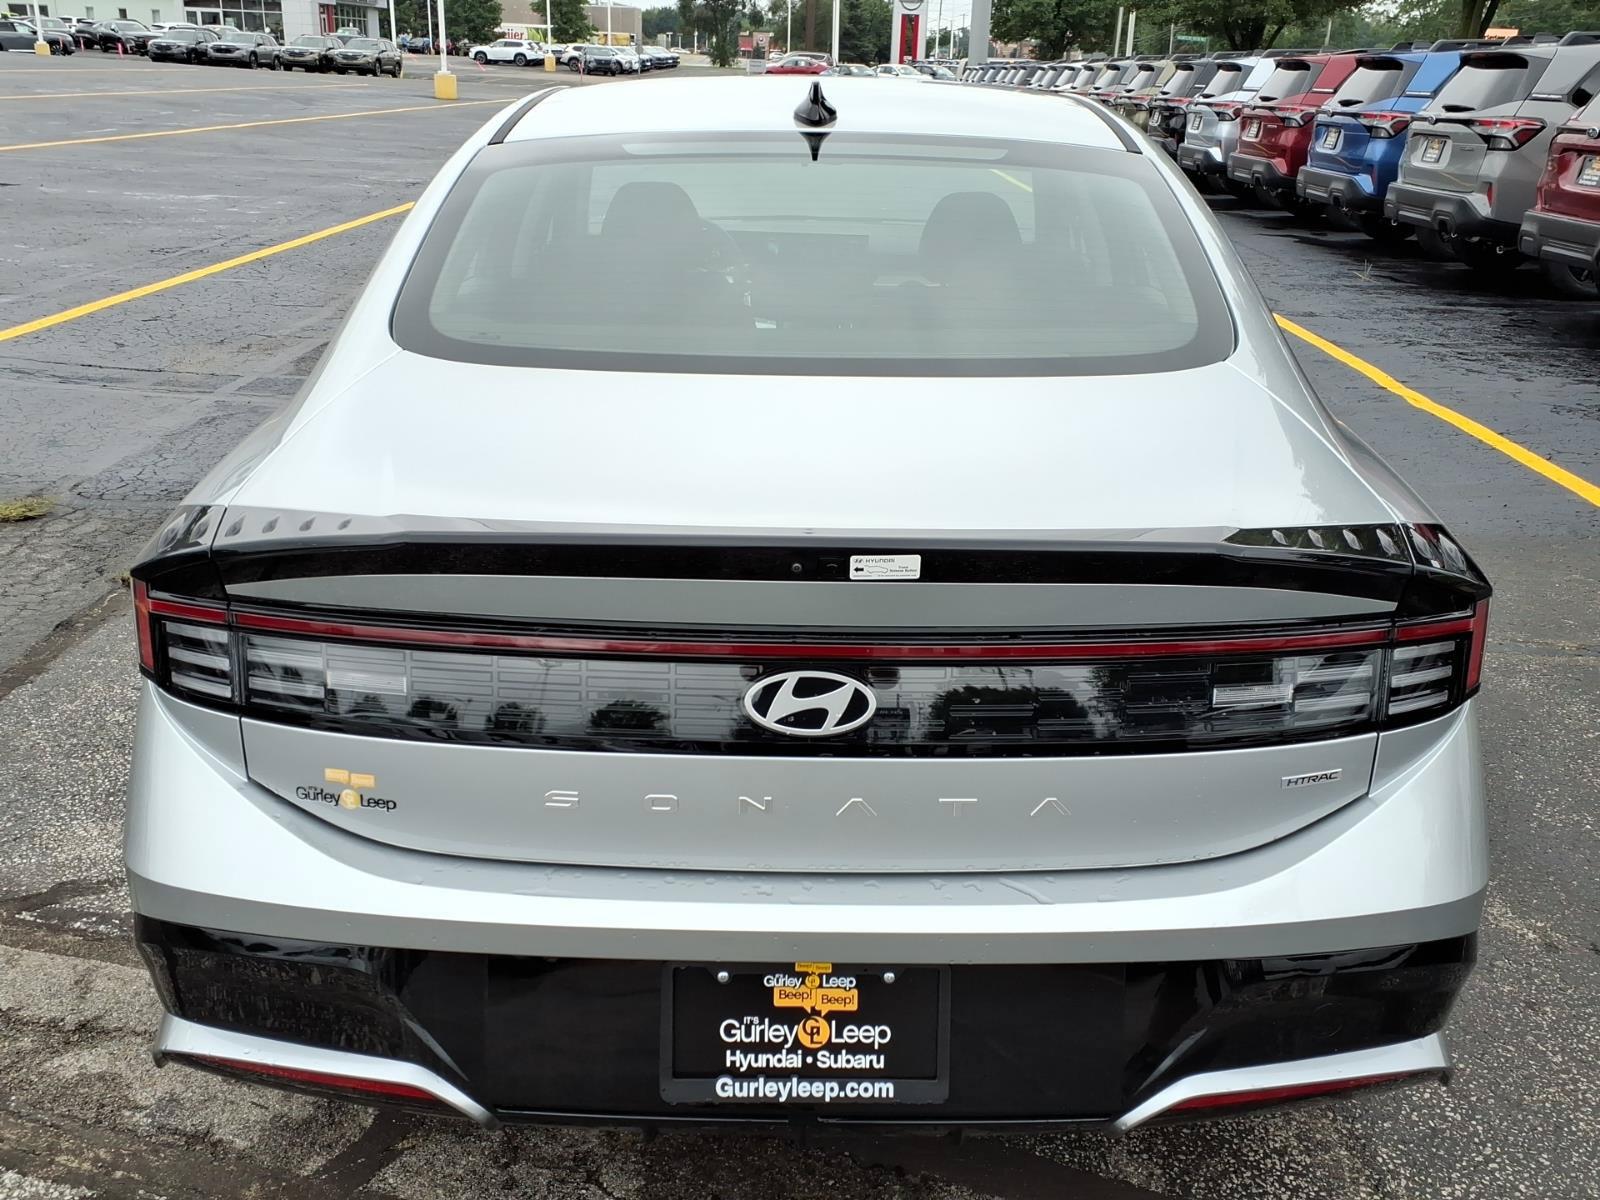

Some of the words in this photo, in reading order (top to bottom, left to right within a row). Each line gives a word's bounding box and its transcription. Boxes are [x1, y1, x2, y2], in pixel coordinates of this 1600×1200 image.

[1286, 771, 1339, 787] HTRAC
[295, 786, 341, 806] Gurley
[360, 794, 397, 812] Leep
[544, 790, 1072, 817] SONATA
[763, 974, 802, 989] Gurley
[822, 974, 857, 991] Leep
[779, 989, 812, 1002] Beep!
[821, 994, 855, 1007] Beep!
[743, 1016, 759, 1025] IT'S
[719, 1018, 799, 1048] Gurley
[831, 1020, 891, 1049] Leep
[725, 1050, 801, 1072] Hyundai
[816, 1050, 885, 1068] Subaru
[715, 1077, 895, 1102] Gurleyleep.com
